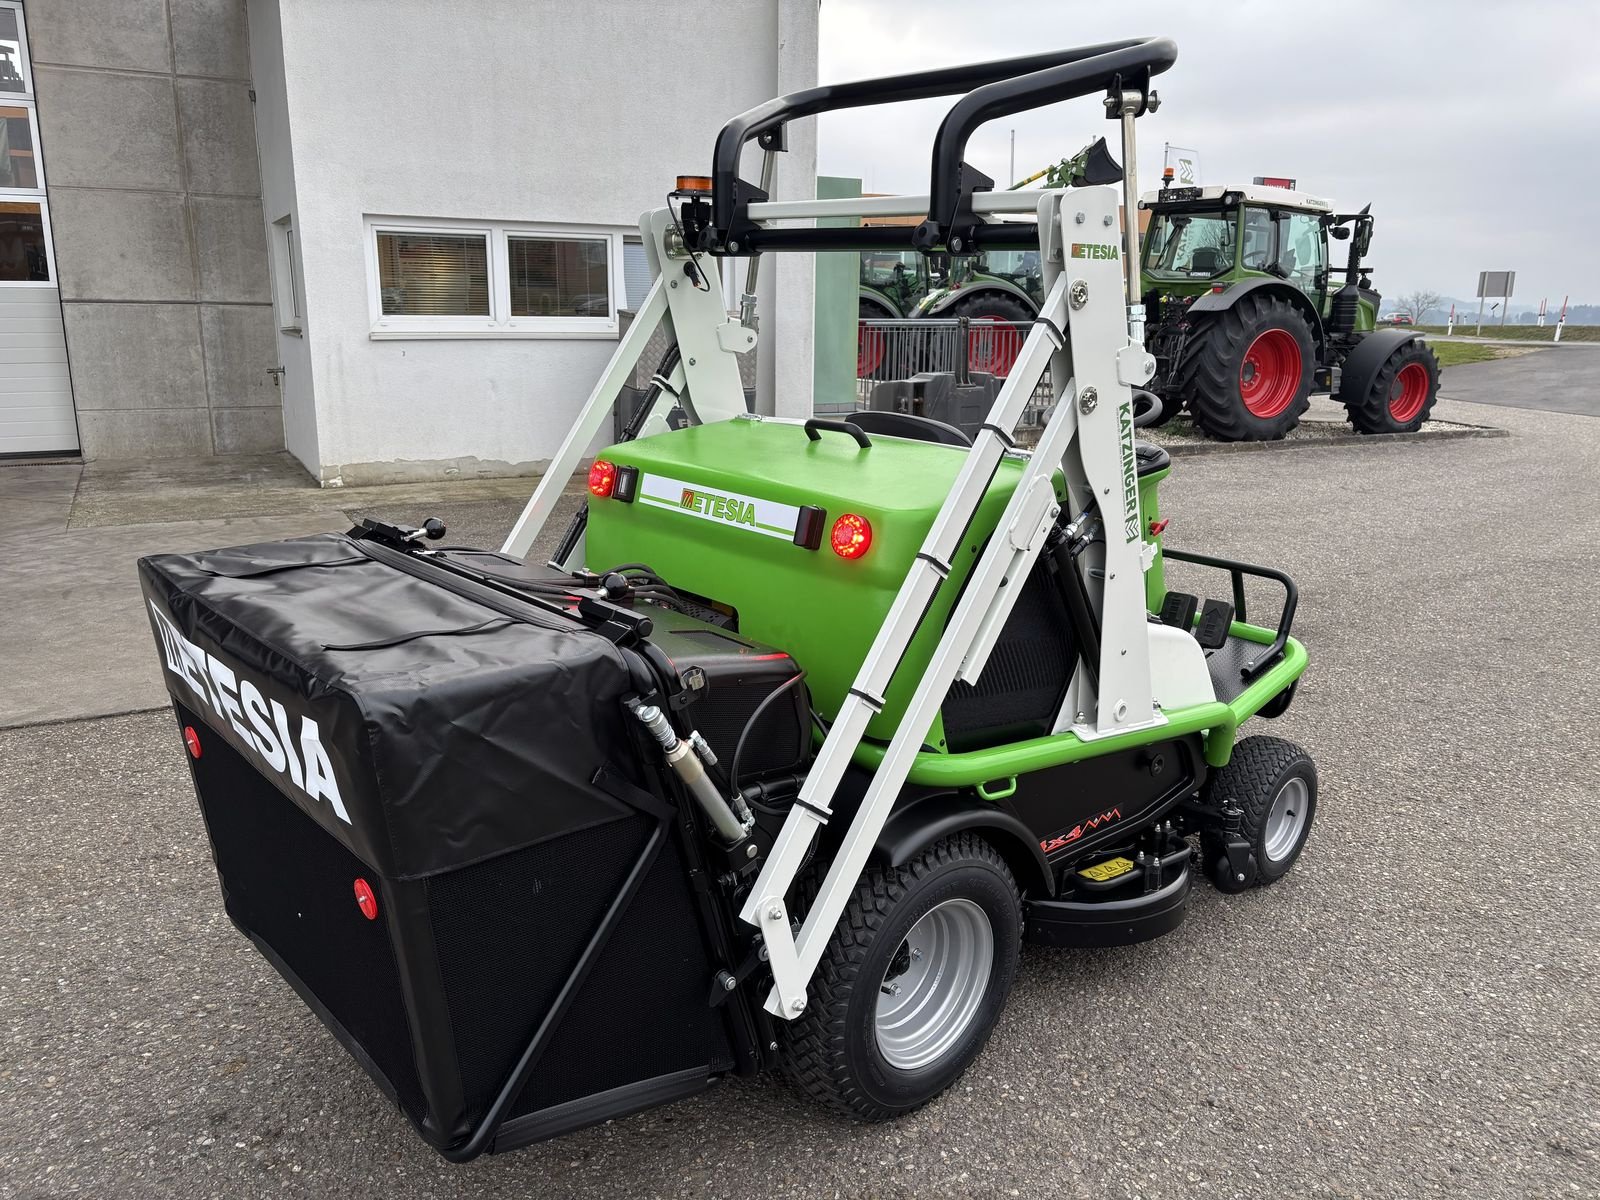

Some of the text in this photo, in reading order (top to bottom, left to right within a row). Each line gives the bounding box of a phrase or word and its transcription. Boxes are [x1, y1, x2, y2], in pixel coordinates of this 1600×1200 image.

[1078, 243, 1119, 260] ETESIA
[1119, 402, 1137, 514] KATZINGER
[689, 489, 756, 526] ETESIA
[176, 633, 353, 826] ETESIA
